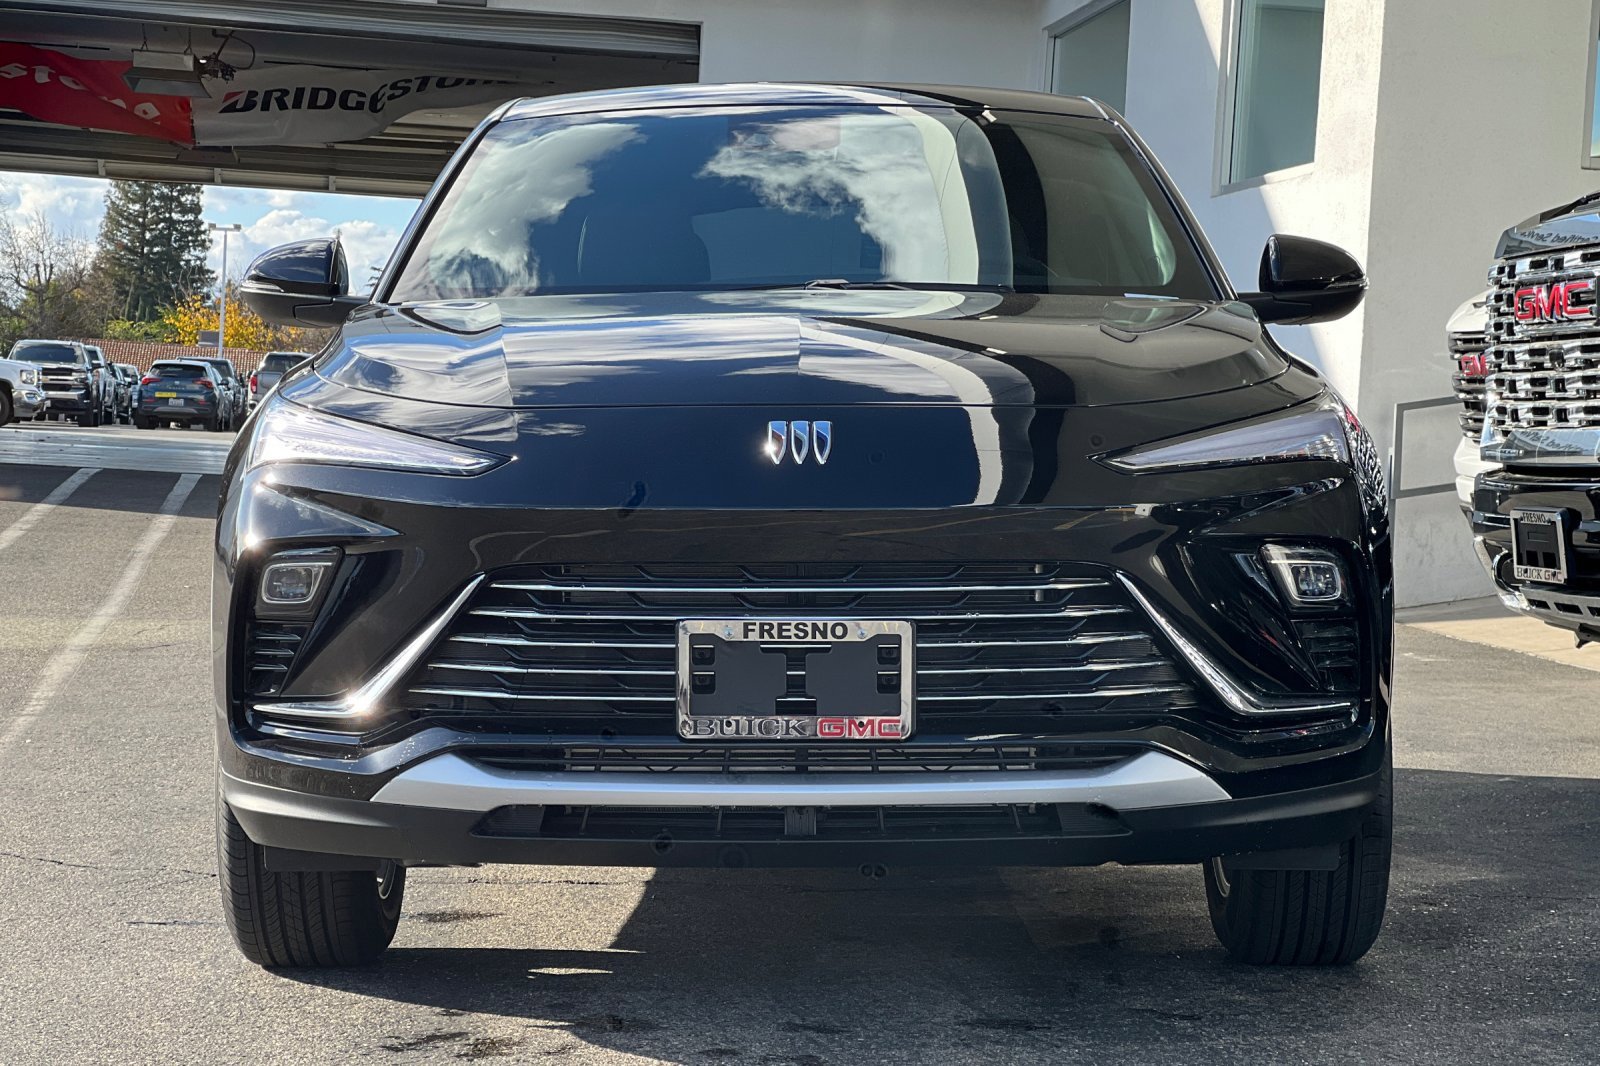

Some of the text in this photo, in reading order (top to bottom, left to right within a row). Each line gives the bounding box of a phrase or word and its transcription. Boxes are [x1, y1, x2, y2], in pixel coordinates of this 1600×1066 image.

[220, 76, 517, 113] BRIDGESTO
[1514, 282, 1590, 321] GMC
[1461, 353, 1489, 376] GM
[1522, 512, 1546, 522] FRESNO
[1516, 567, 1542, 579] BUICK
[742, 622, 848, 640] FRESNO
[692, 717, 902, 737] BUICK GMC
